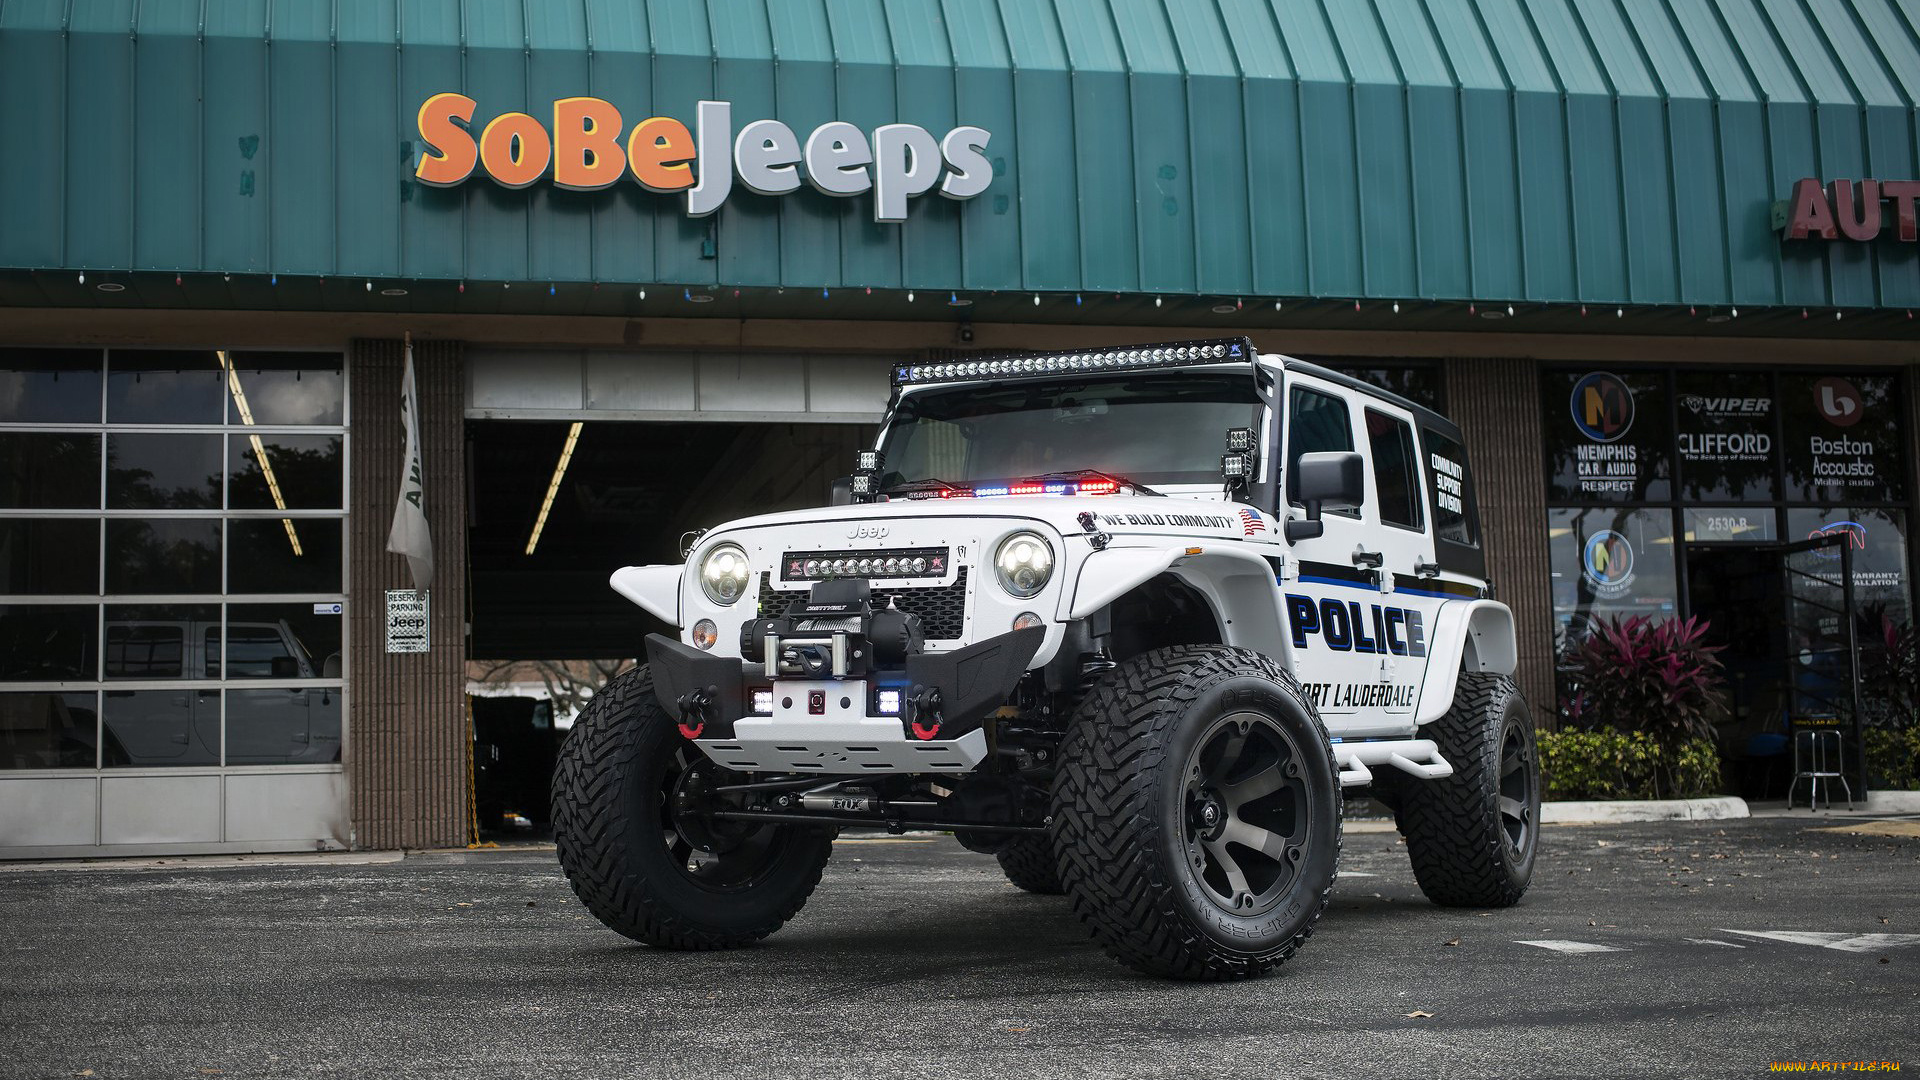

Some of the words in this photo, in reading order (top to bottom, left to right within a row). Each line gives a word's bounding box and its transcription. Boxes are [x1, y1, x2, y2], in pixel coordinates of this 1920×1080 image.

[1704, 397, 1772, 412] VIPER
[1678, 433, 1771, 454] CLIFFORD
[1810, 434, 1874, 455] Boston
[1577, 444, 1637, 460] MEMPHIS
[1431, 452, 1463, 481] COMMUNITY
[1578, 461, 1600, 476] CAR
[1606, 461, 1637, 476] AUDIO
[1812, 455, 1875, 476] Accoustic
[1436, 472, 1462, 497] SUPPORT
[1581, 480, 1636, 492] RESPECT
[1814, 477, 1845, 487] Mobile
[1848, 478, 1875, 487] audio
[1438, 490, 1462, 515] DIVISION
[1124, 513, 1166, 526] BUILD
[846, 523, 890, 540] Jeep
[390, 603, 424, 611] PARKING
[390, 616, 425, 629] Jeep
[1284, 592, 1427, 658] POLICE
[1302, 682, 1332, 707] ORT
[1333, 683, 1415, 707] LAUDERDALE
[832, 796, 867, 811] FOX
